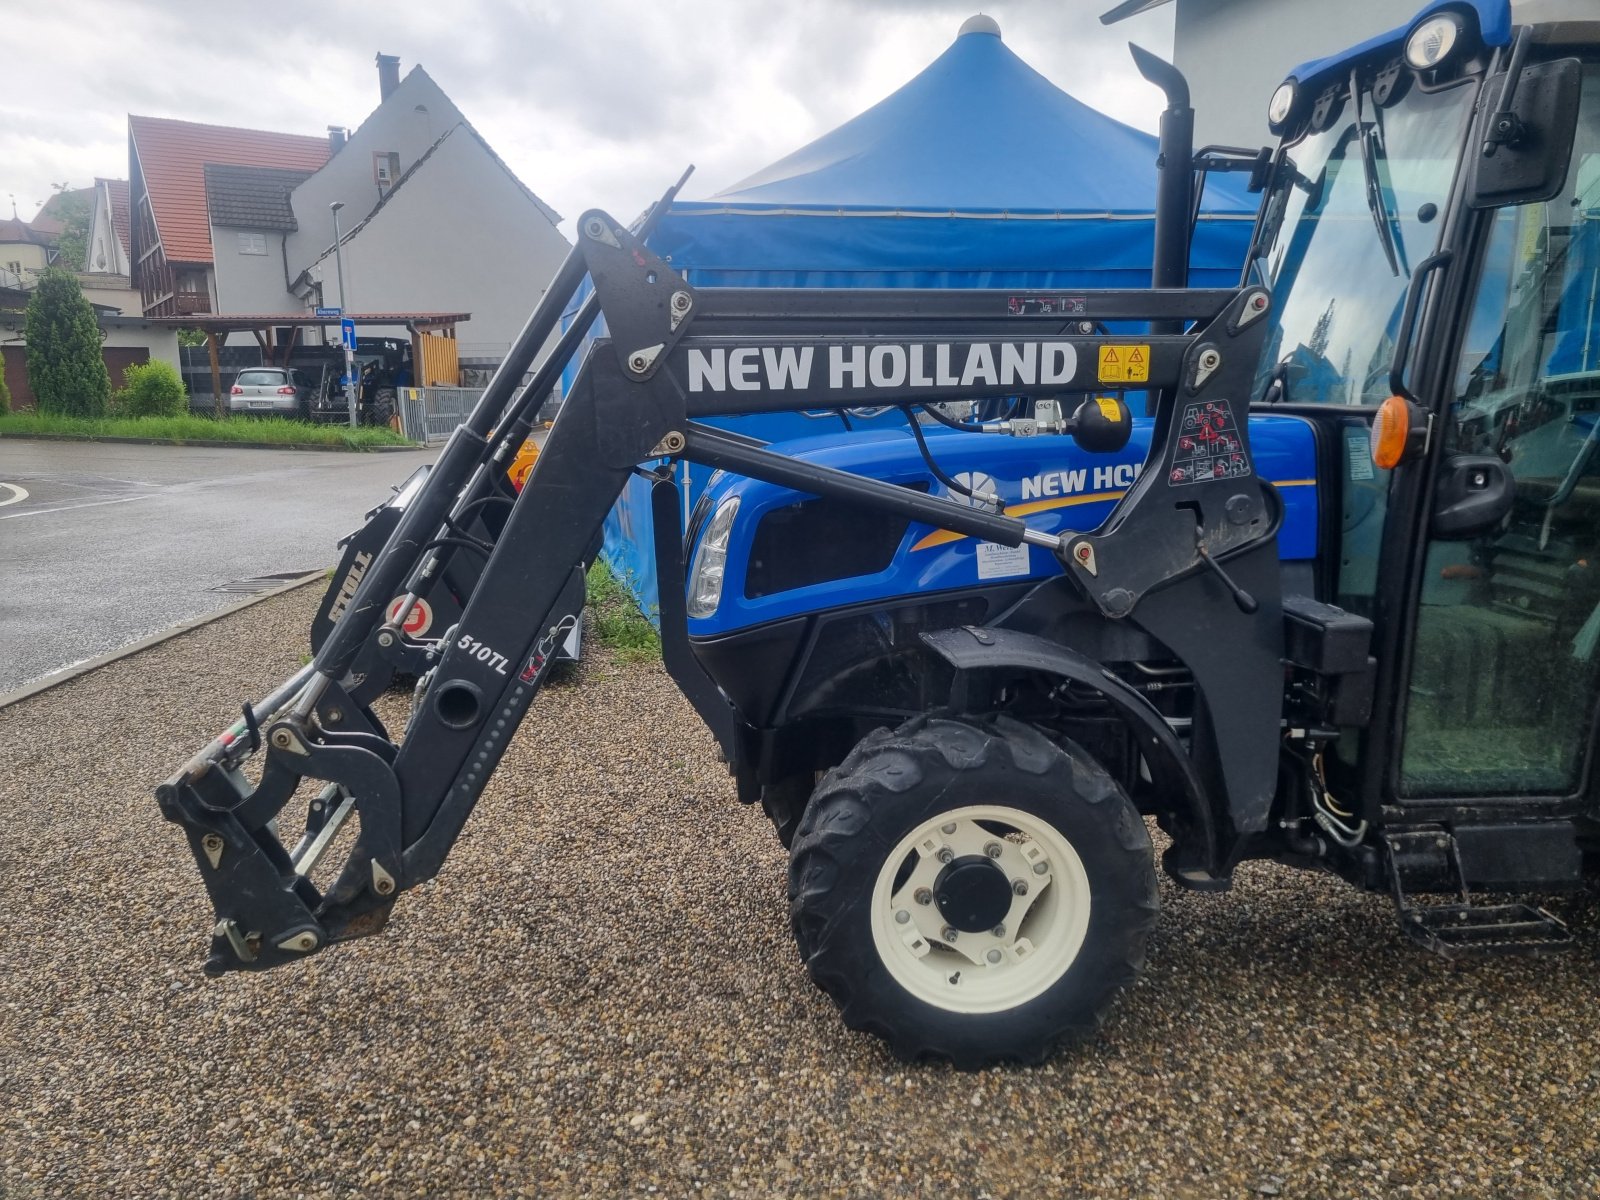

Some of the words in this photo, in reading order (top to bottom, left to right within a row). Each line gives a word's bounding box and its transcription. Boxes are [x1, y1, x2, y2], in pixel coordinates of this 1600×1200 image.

[688, 346, 814, 392] NEW
[829, 342, 1078, 389] HOLLAND
[1021, 468, 1087, 500] NEW
[328, 550, 373, 623] STOLL
[457, 634, 510, 676] 510TL
